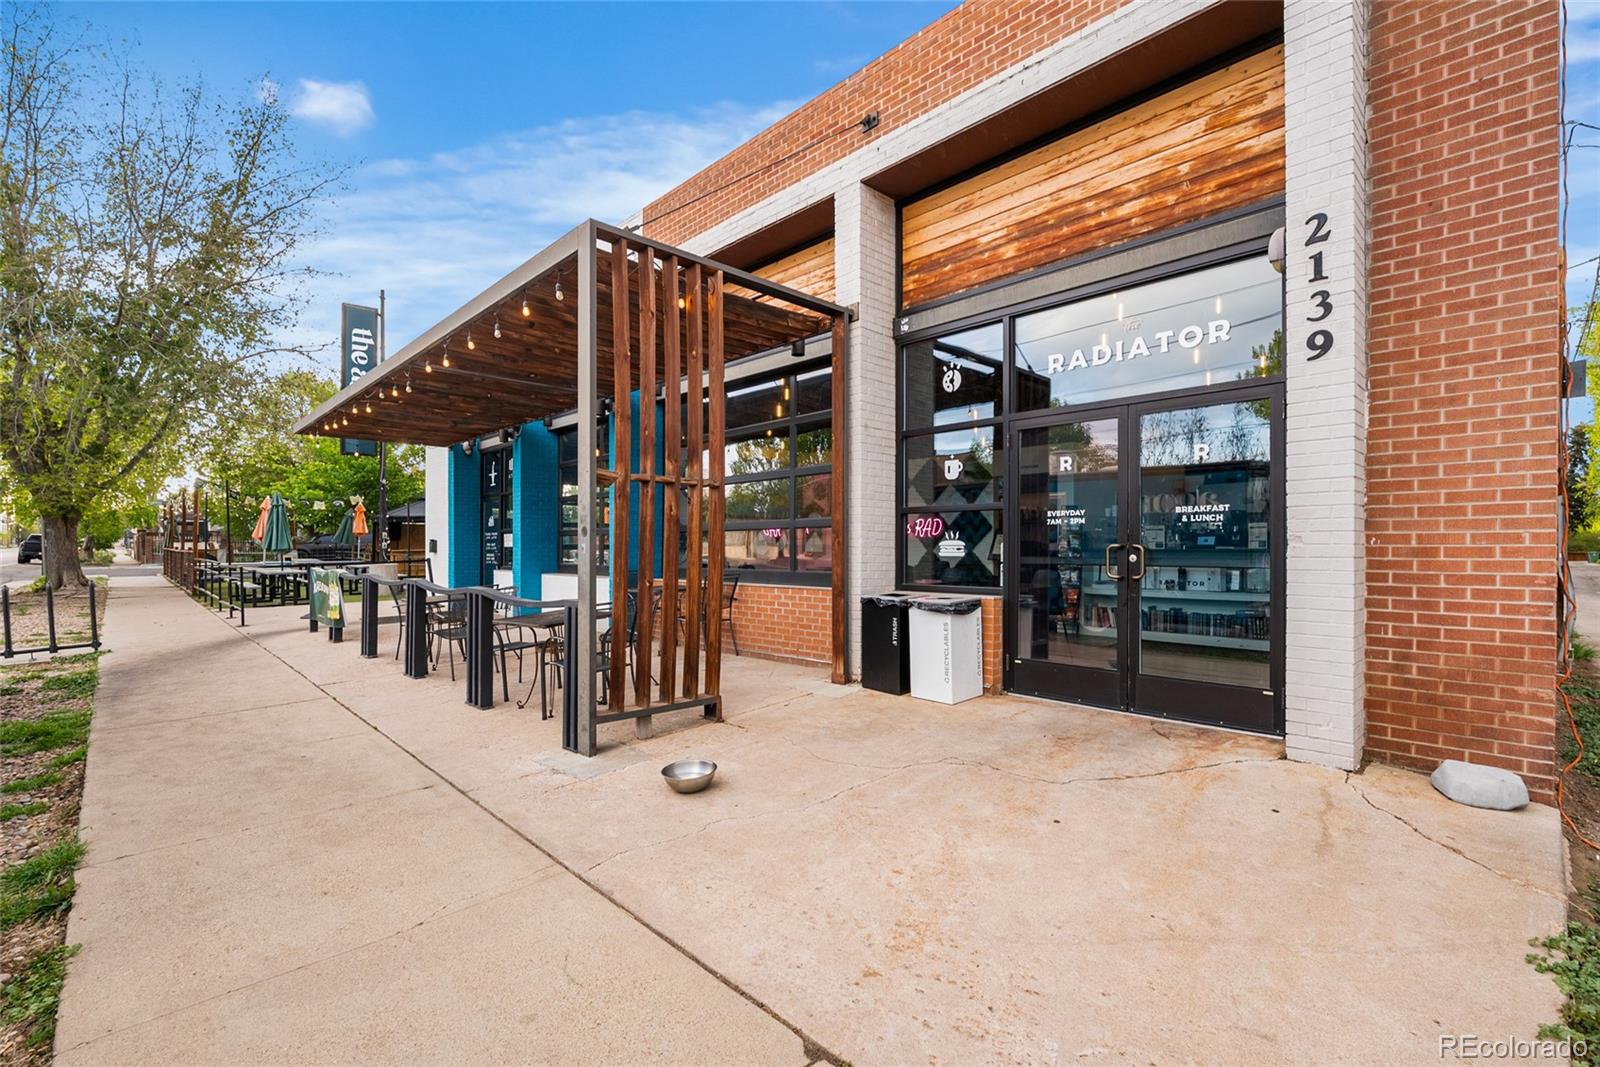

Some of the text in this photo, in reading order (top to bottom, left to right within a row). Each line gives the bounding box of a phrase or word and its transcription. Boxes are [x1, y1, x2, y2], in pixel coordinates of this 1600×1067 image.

[1304, 212, 1334, 362] 2139
[351, 328, 375, 365] the
[1047, 319, 1231, 374] RADIATOR
[1194, 443, 1210, 461] R
[1059, 456, 1073, 472] R
[1046, 509, 1086, 517] EVERYDAY
[1175, 504, 1230, 513] BREAKFAST
[1046, 518, 1062, 526] 7AM
[1069, 517, 1086, 525] 2PM
[1181, 513, 1224, 522] & LUNCH
[915, 518, 943, 538] RAD
